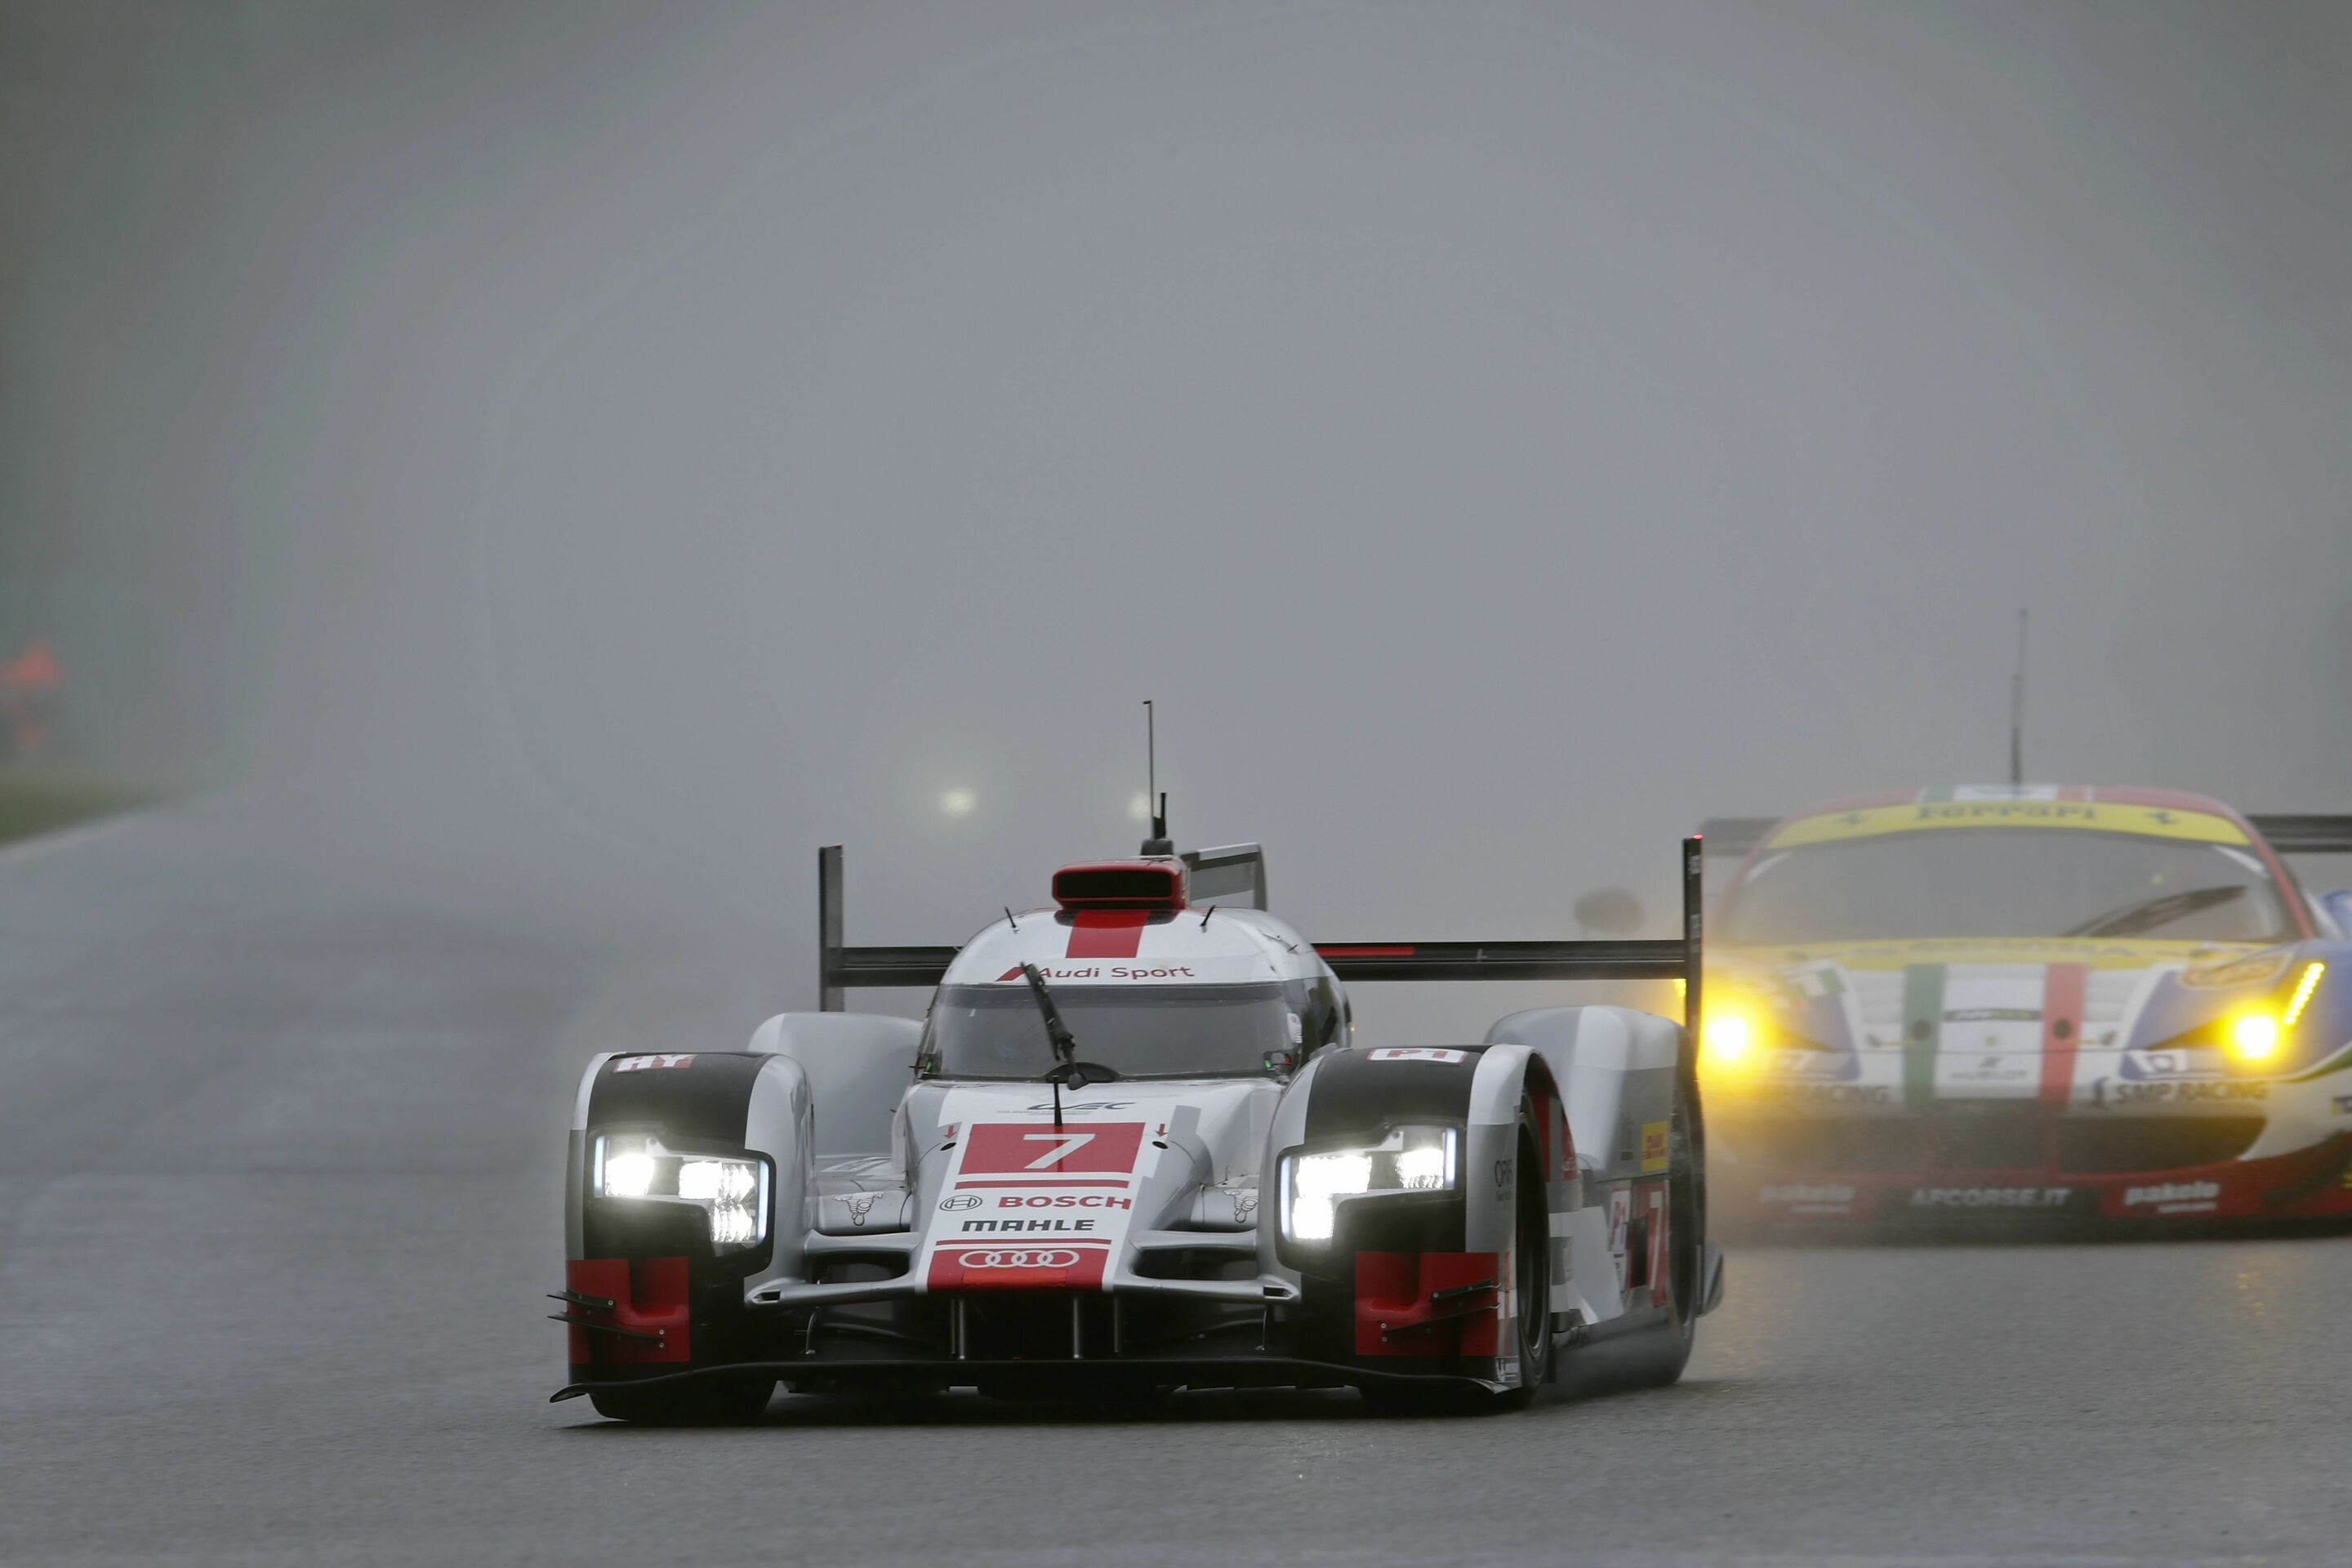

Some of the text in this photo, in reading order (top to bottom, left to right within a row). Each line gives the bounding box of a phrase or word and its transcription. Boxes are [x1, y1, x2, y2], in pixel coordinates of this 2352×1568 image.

[1916, 804, 2096, 821] Ferrari
[1039, 967, 1195, 980] Audi Sport
[1388, 1049, 1450, 1060] P1
[617, 1054, 697, 1071] HY
[2117, 1080, 2269, 1103] SMP RACING
[1022, 1133, 1097, 1169] 7
[998, 1196, 1132, 1210] BOSCH
[961, 1219, 1095, 1232] MAHLE
